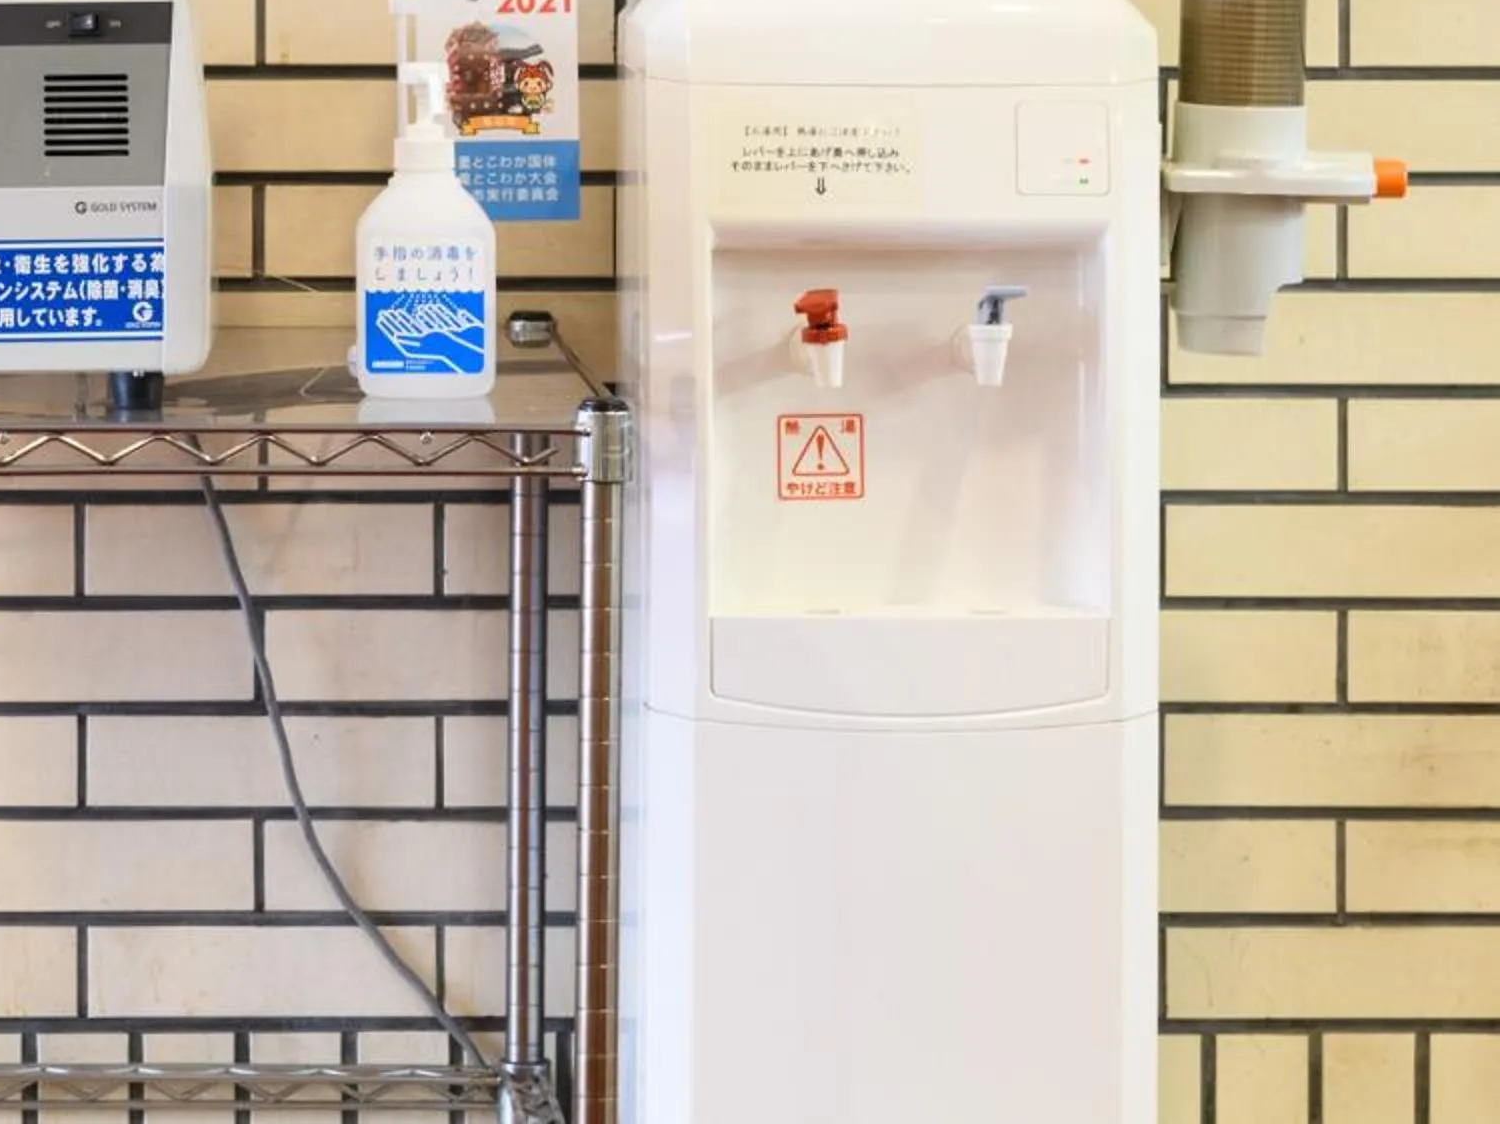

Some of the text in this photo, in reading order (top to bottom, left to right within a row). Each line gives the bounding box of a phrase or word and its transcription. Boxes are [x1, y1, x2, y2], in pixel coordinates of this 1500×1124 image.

[90, 202, 117, 213] GOLD
[120, 201, 157, 212] SYSTEM
[374, 245, 478, 262] 手指の消毒を
[785, 481, 857, 495] やけど注意
